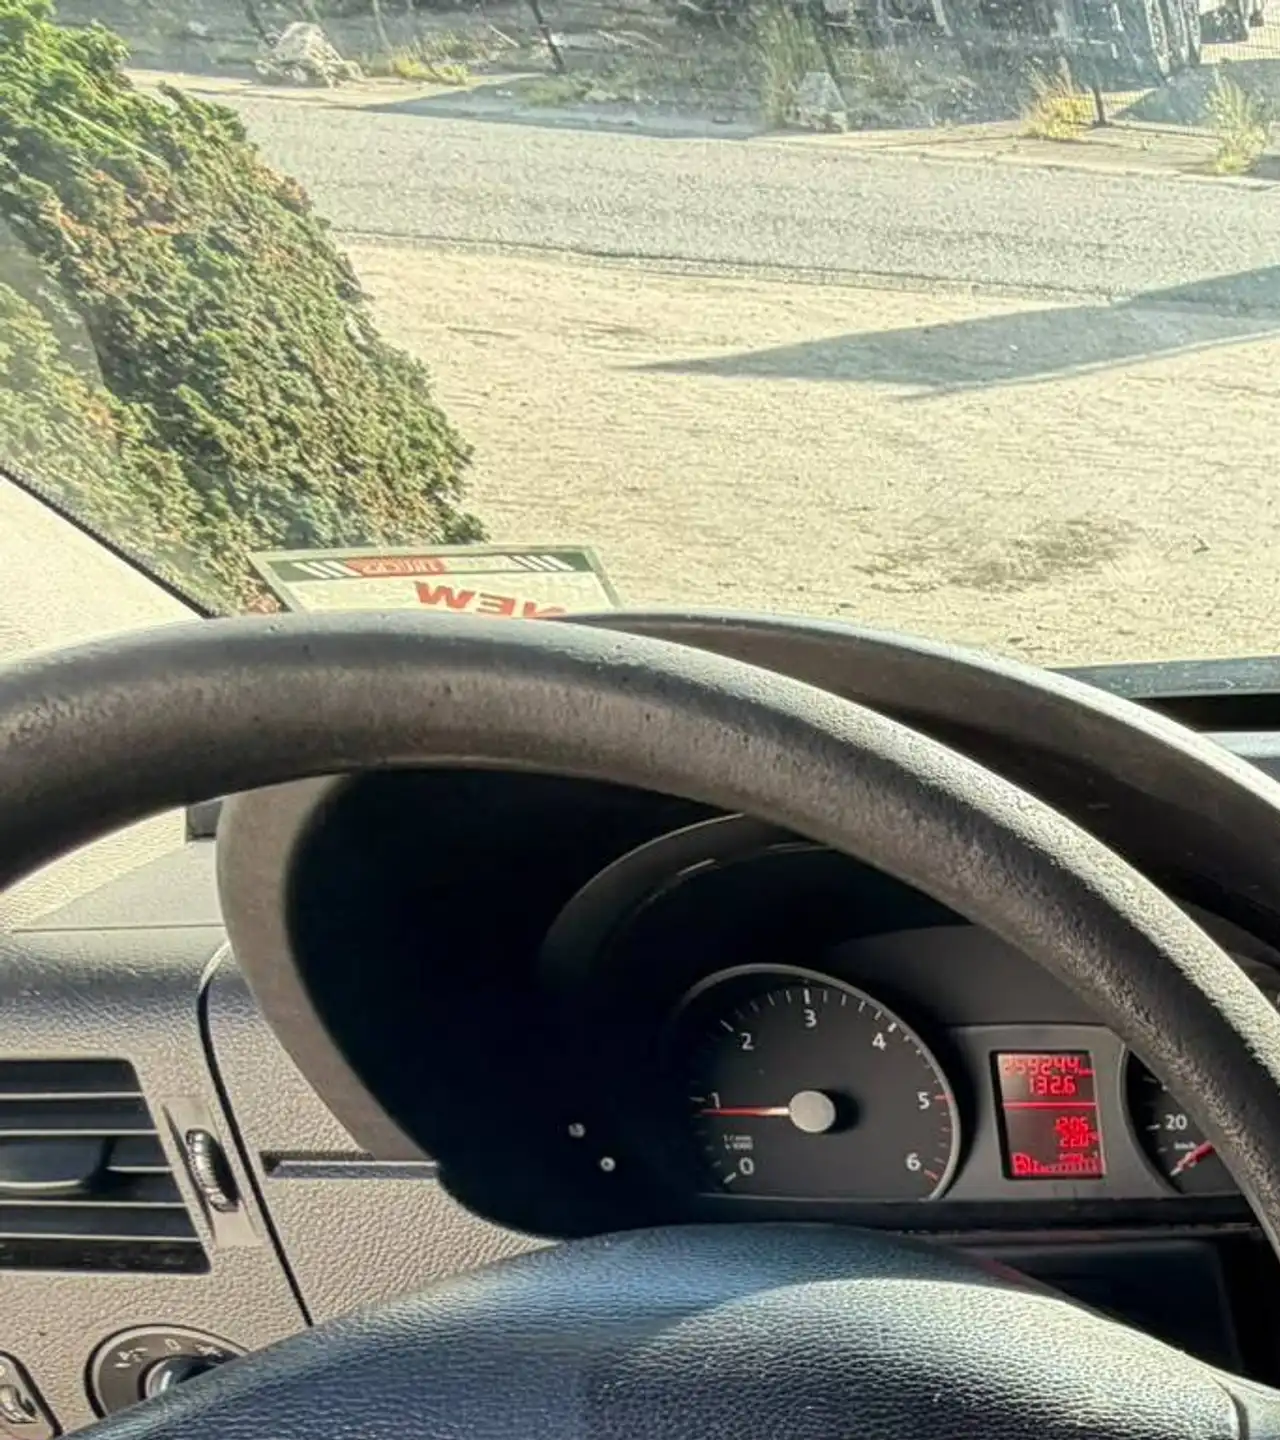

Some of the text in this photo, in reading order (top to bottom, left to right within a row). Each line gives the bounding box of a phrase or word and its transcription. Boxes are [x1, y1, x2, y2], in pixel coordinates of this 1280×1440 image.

[803, 1007, 818, 1029] 3
[739, 1031, 755, 1052] 2
[871, 1037, 888, 1053] 4
[709, 1091, 721, 1110] 1
[916, 1090, 931, 1111] 5
[1164, 1113, 1189, 1132] 20
[738, 1156, 755, 1177] 0
[904, 1153, 923, 1172] 6
